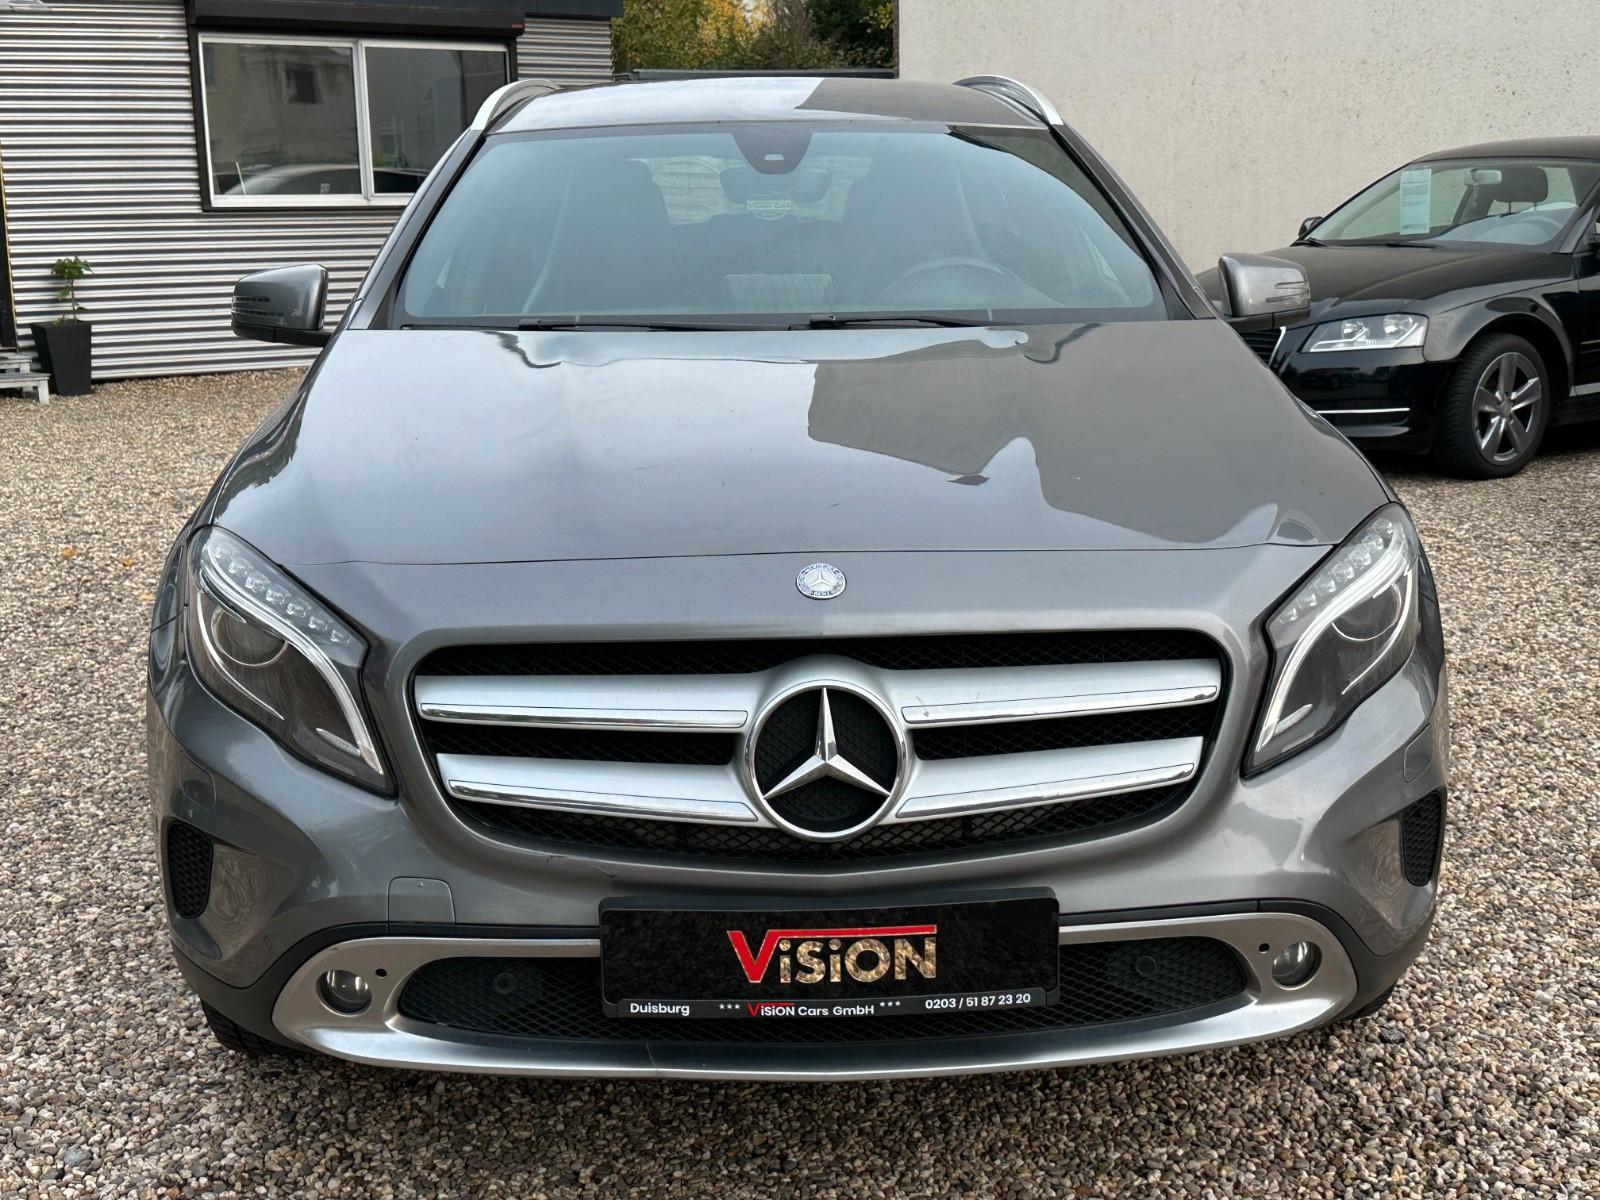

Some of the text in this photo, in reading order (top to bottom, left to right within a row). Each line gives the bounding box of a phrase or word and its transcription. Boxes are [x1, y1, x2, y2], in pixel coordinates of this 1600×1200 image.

[726, 925, 937, 983] ViSiON
[925, 992, 1031, 1009] 0203 / 51 87 23 20
[630, 1002, 690, 1017] Duisburg
[747, 1002, 875, 1017] ViSiON Cars GmbH
